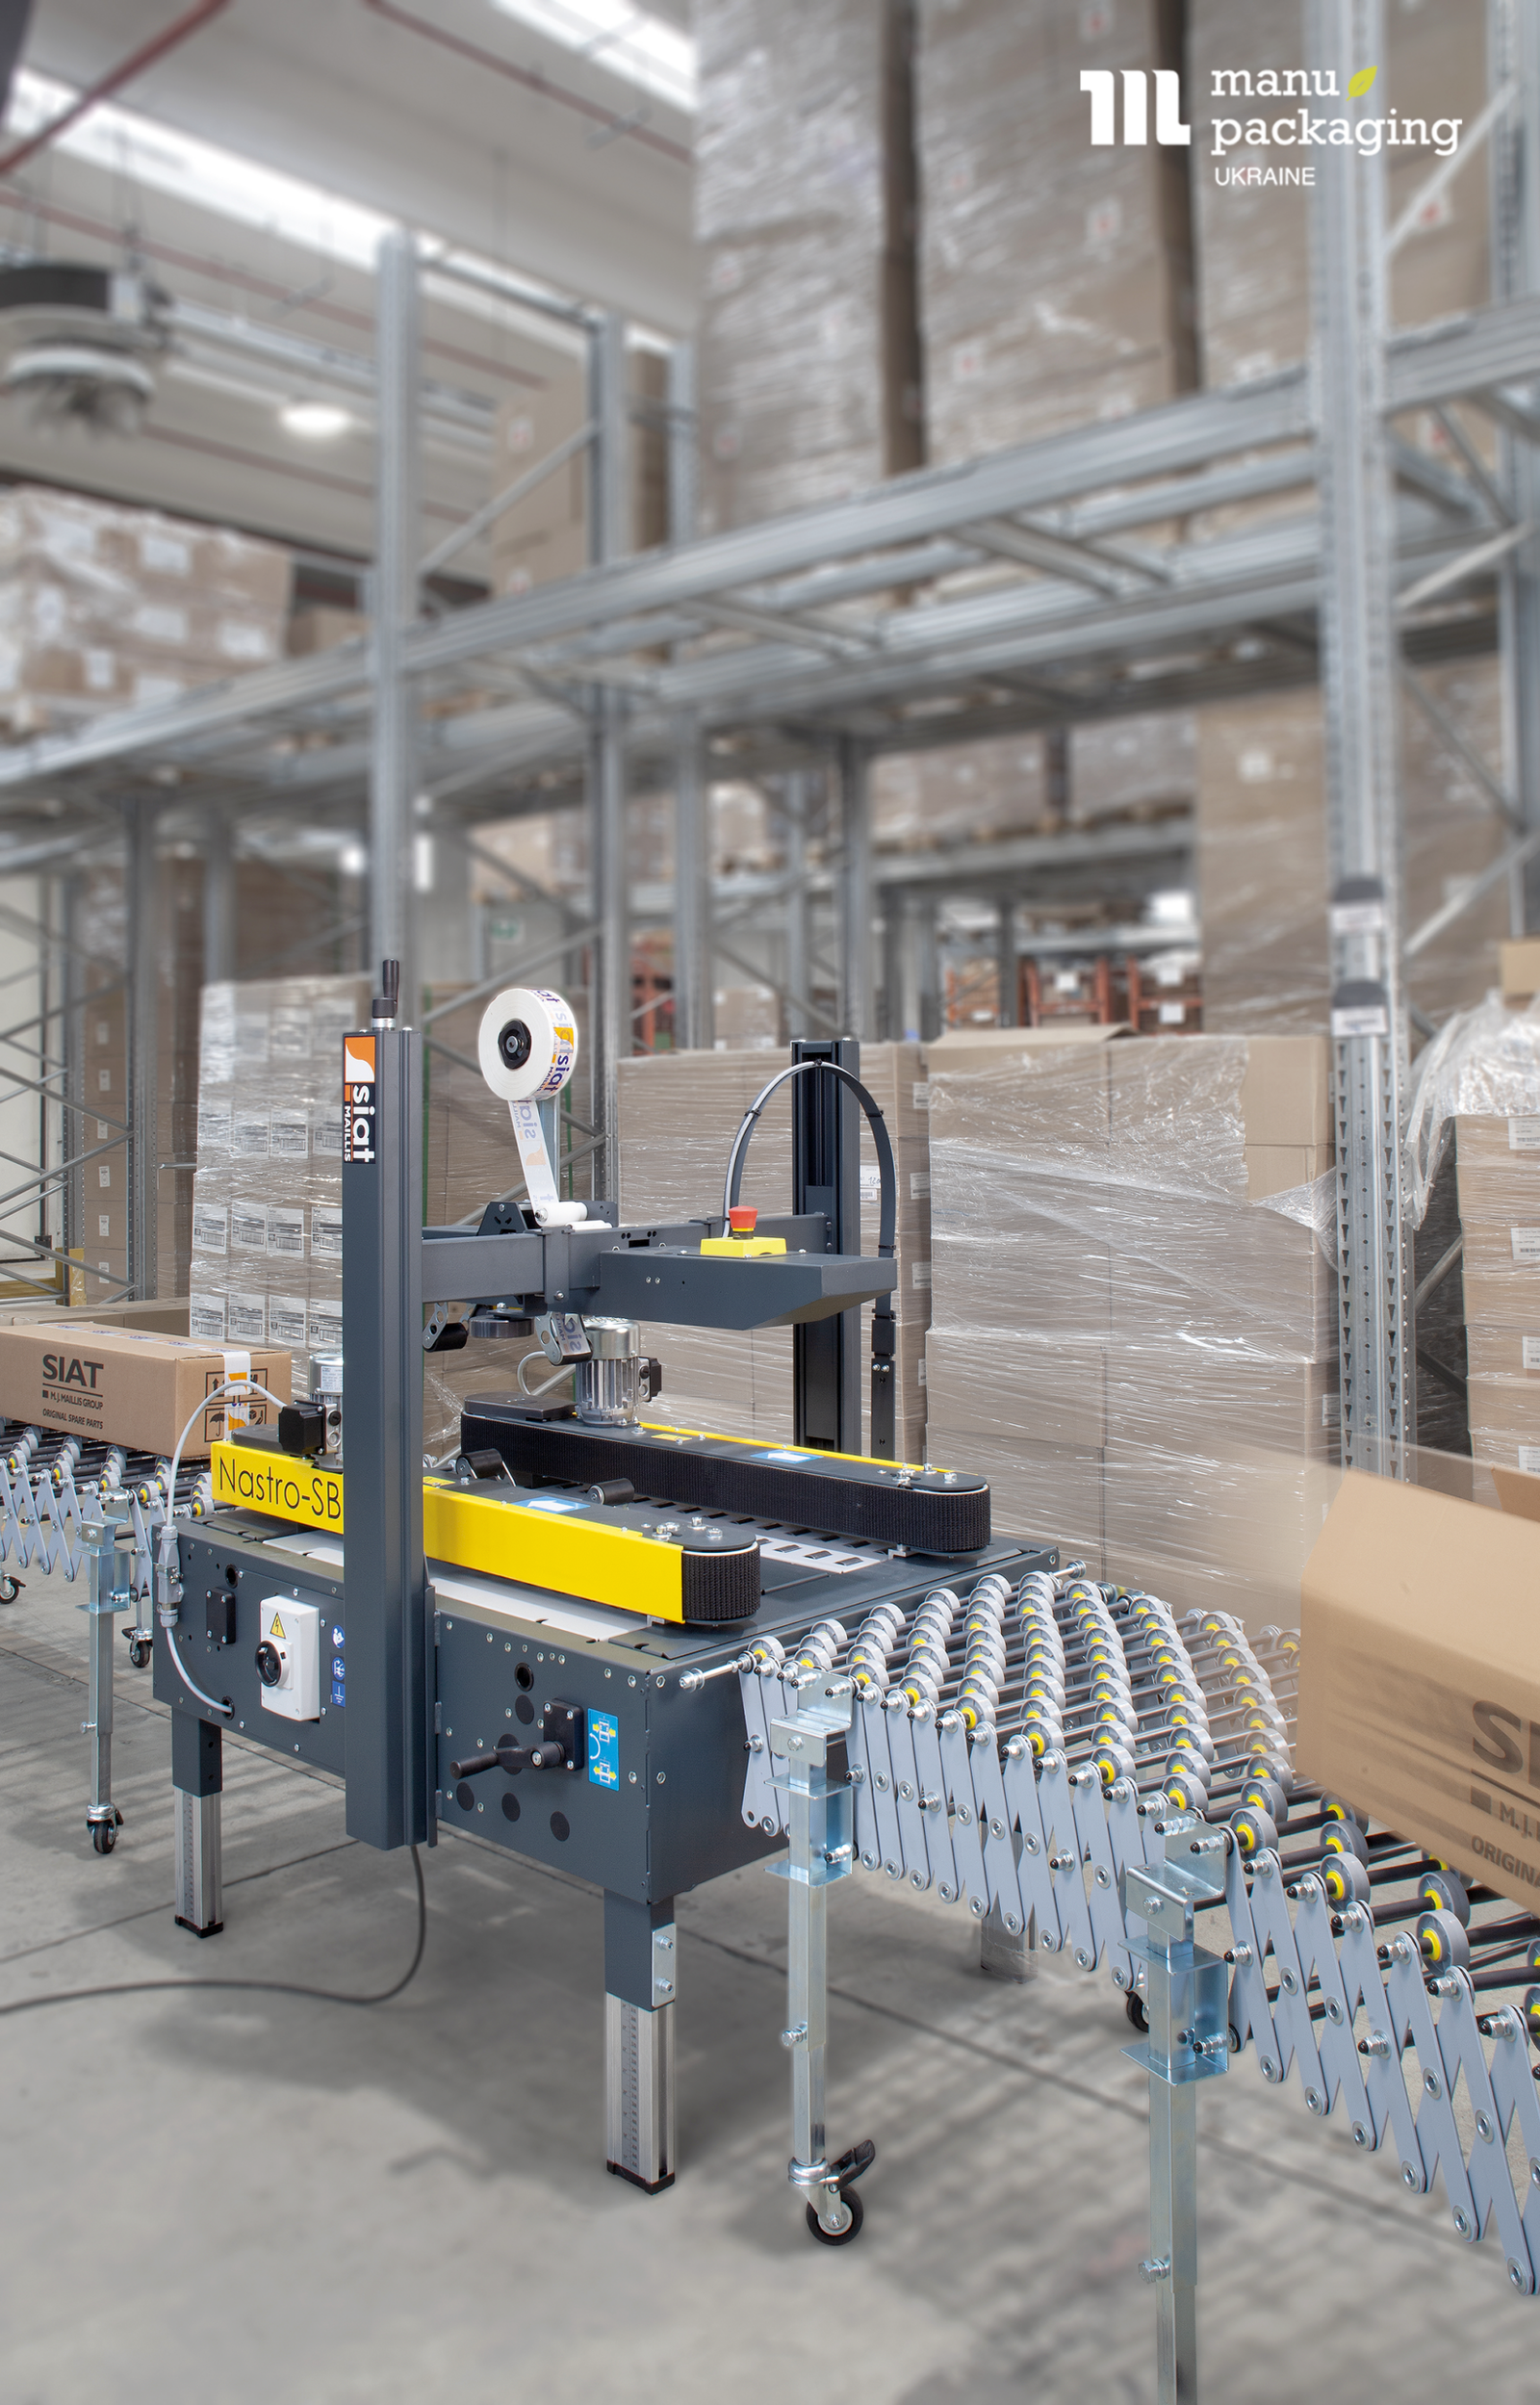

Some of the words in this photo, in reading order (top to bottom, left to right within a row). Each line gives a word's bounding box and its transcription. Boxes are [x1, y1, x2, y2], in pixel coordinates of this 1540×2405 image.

[543, 1055, 570, 1092] siat
[352, 1085, 375, 1163] siat
[42, 1354, 104, 1389] SIAT
[42, 1408, 67, 1422] ORIGINAL
[68, 1413, 86, 1426] SPARE
[86, 1417, 104, 1430] PARTS
[83, 1398, 104, 1410] GROUP
[219, 1456, 342, 1520] Nastro-SB
